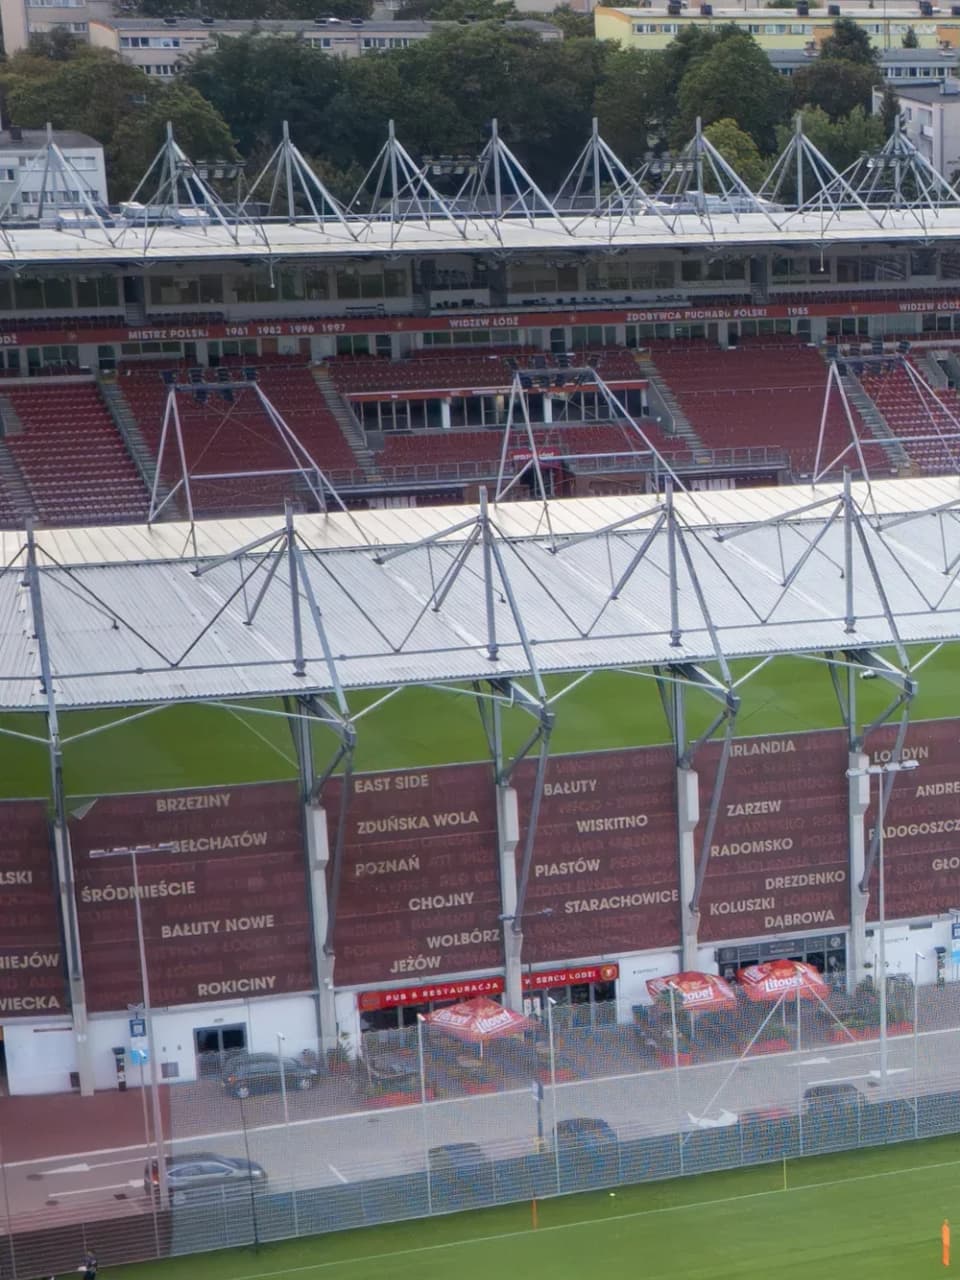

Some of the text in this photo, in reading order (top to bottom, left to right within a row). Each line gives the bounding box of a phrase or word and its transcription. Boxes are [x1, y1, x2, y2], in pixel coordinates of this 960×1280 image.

[734, 308, 767, 318] POLSKI
[730, 740, 796, 758] IRLANDIA
[874, 746, 929, 763] LODYN
[355, 775, 429, 793] EAST SIDE
[544, 779, 597, 796] BAŁUTY
[156, 793, 231, 813] BRZEZINY
[727, 800, 782, 817] ZARZEW
[357, 811, 479, 834] ZDUŃSKA WOLA
[576, 814, 648, 833] WISKITNO
[170, 831, 267, 854] BEŁCHATÓW
[710, 838, 793, 857] RADOMSKO
[355, 855, 420, 877] POZNAŃ
[535, 857, 600, 877] PIASTÓW
[765, 870, 846, 890] DREZDENKO
[81, 879, 196, 904] ŚRÓDMIEŚCIE
[408, 892, 475, 911] CHOJNY
[564, 889, 679, 914] STARACHOWICE
[710, 897, 775, 915] KOLUSZKI
[161, 915, 274, 939] BAŁUTY NOWE
[764, 910, 835, 929] DĄBROWA
[390, 955, 441, 974] JEŻÓW
[198, 976, 276, 997] ROKICINY
[422, 981, 499, 998] RESTAURACJA
